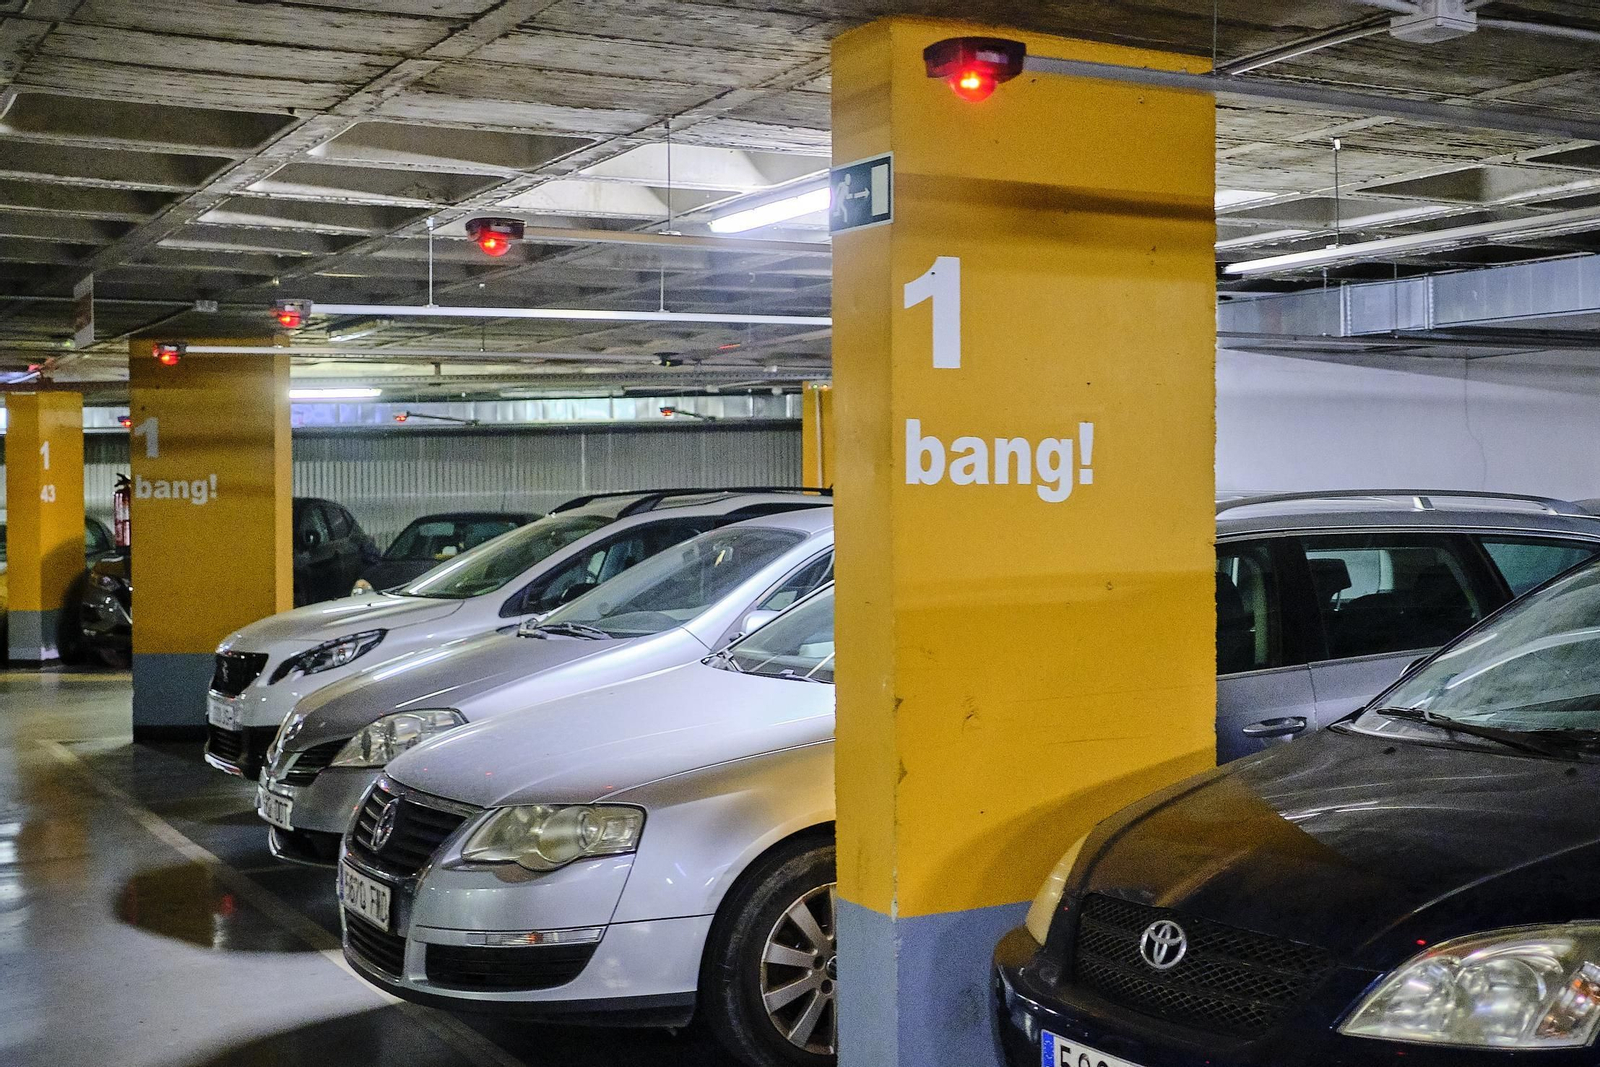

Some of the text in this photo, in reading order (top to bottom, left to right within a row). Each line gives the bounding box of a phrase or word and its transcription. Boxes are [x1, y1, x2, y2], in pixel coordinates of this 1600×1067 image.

[904, 256, 962, 369] 1
[40, 441, 50, 470] 1
[134, 417, 160, 459] 1
[905, 419, 1095, 503] bang!
[40, 485, 56, 503] 43
[134, 474, 218, 505] bang!
